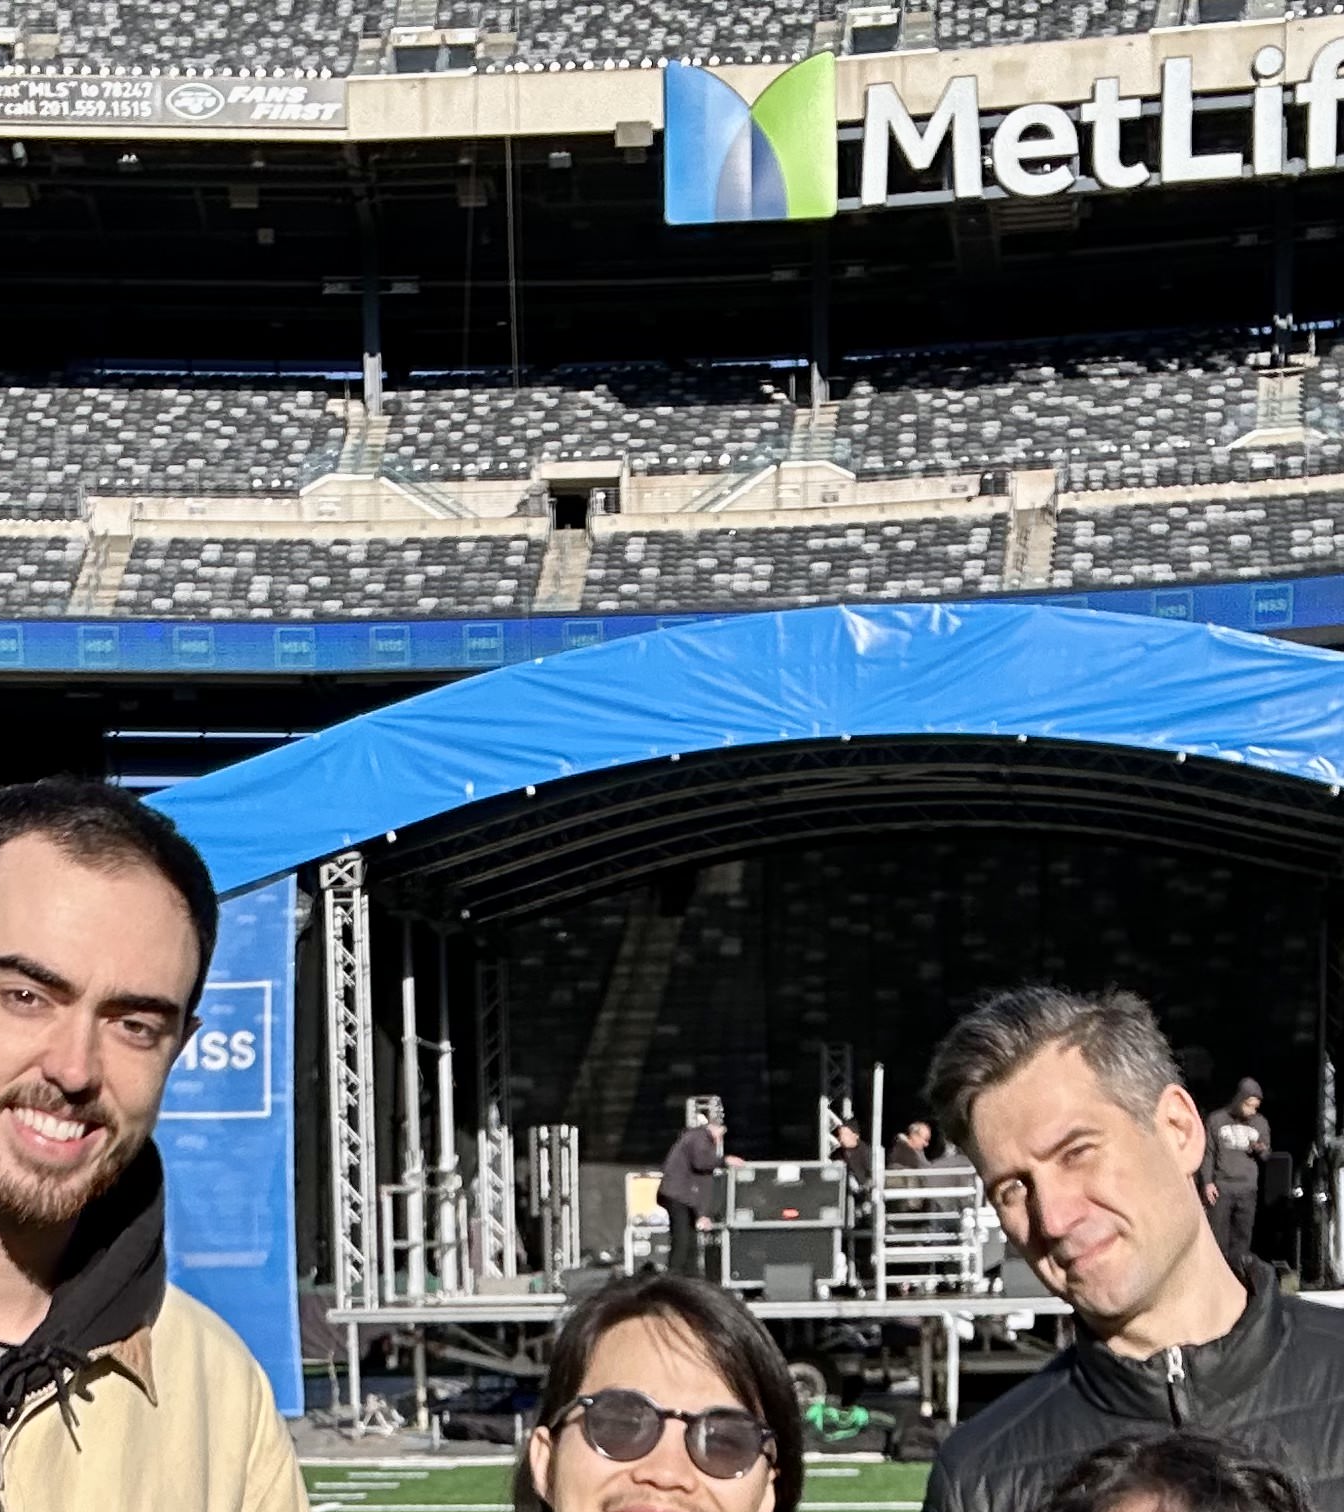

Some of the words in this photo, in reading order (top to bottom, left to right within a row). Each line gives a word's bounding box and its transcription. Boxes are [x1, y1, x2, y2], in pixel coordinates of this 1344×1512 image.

[81, 82, 99, 97] to
[227, 86, 308, 103] FANS
[6, 100, 36, 116] call
[251, 103, 343, 121] FIRST
